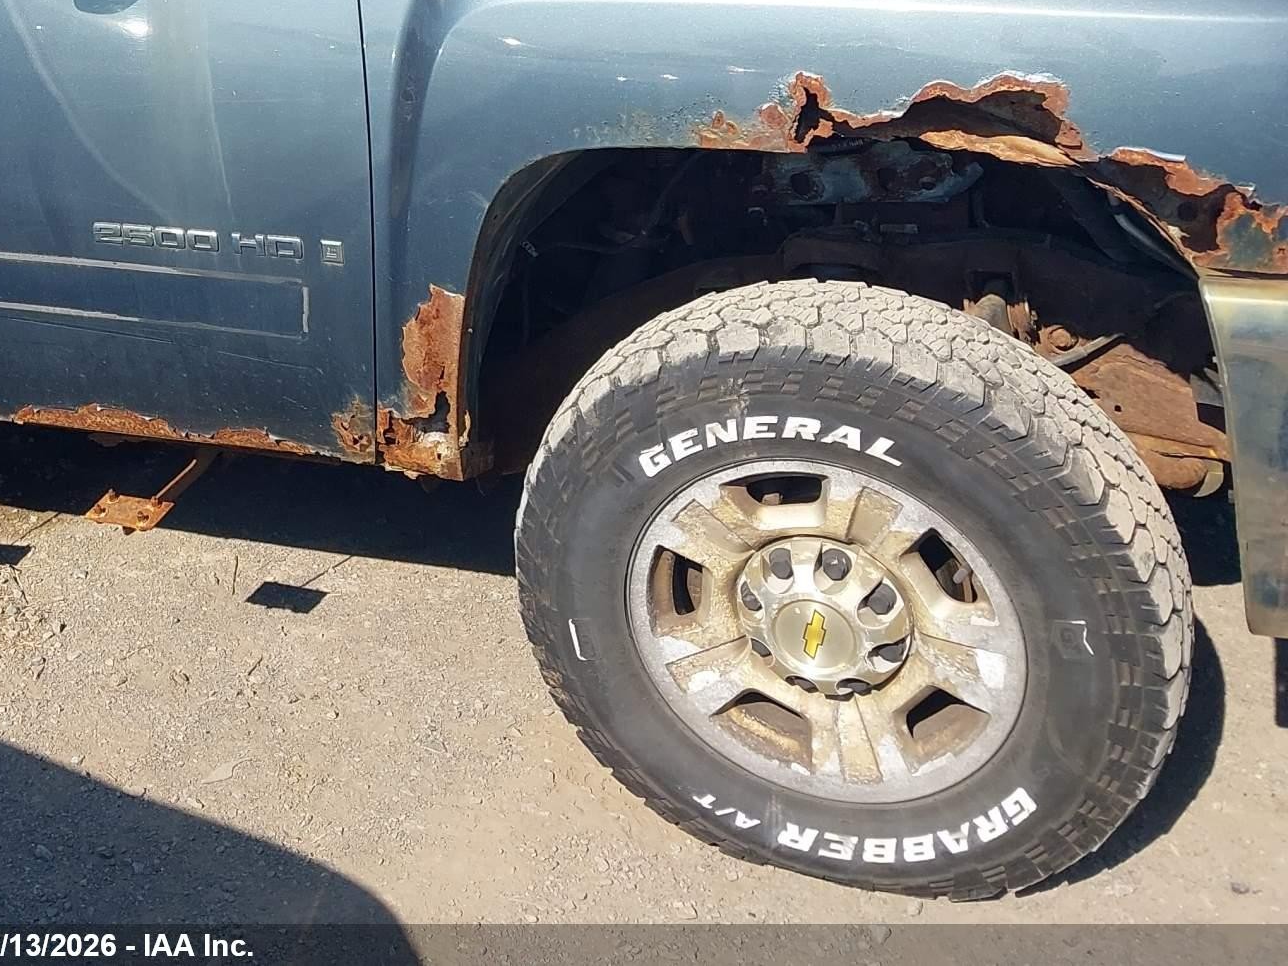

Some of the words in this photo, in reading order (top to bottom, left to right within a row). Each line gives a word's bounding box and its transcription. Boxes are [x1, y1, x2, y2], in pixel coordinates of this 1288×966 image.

[92, 221, 220, 253] 2500
[231, 232, 304, 260] HD
[638, 415, 903, 478] GENERAL
[693, 793, 761, 829] A/T
[777, 787, 1038, 864] GRABBER
